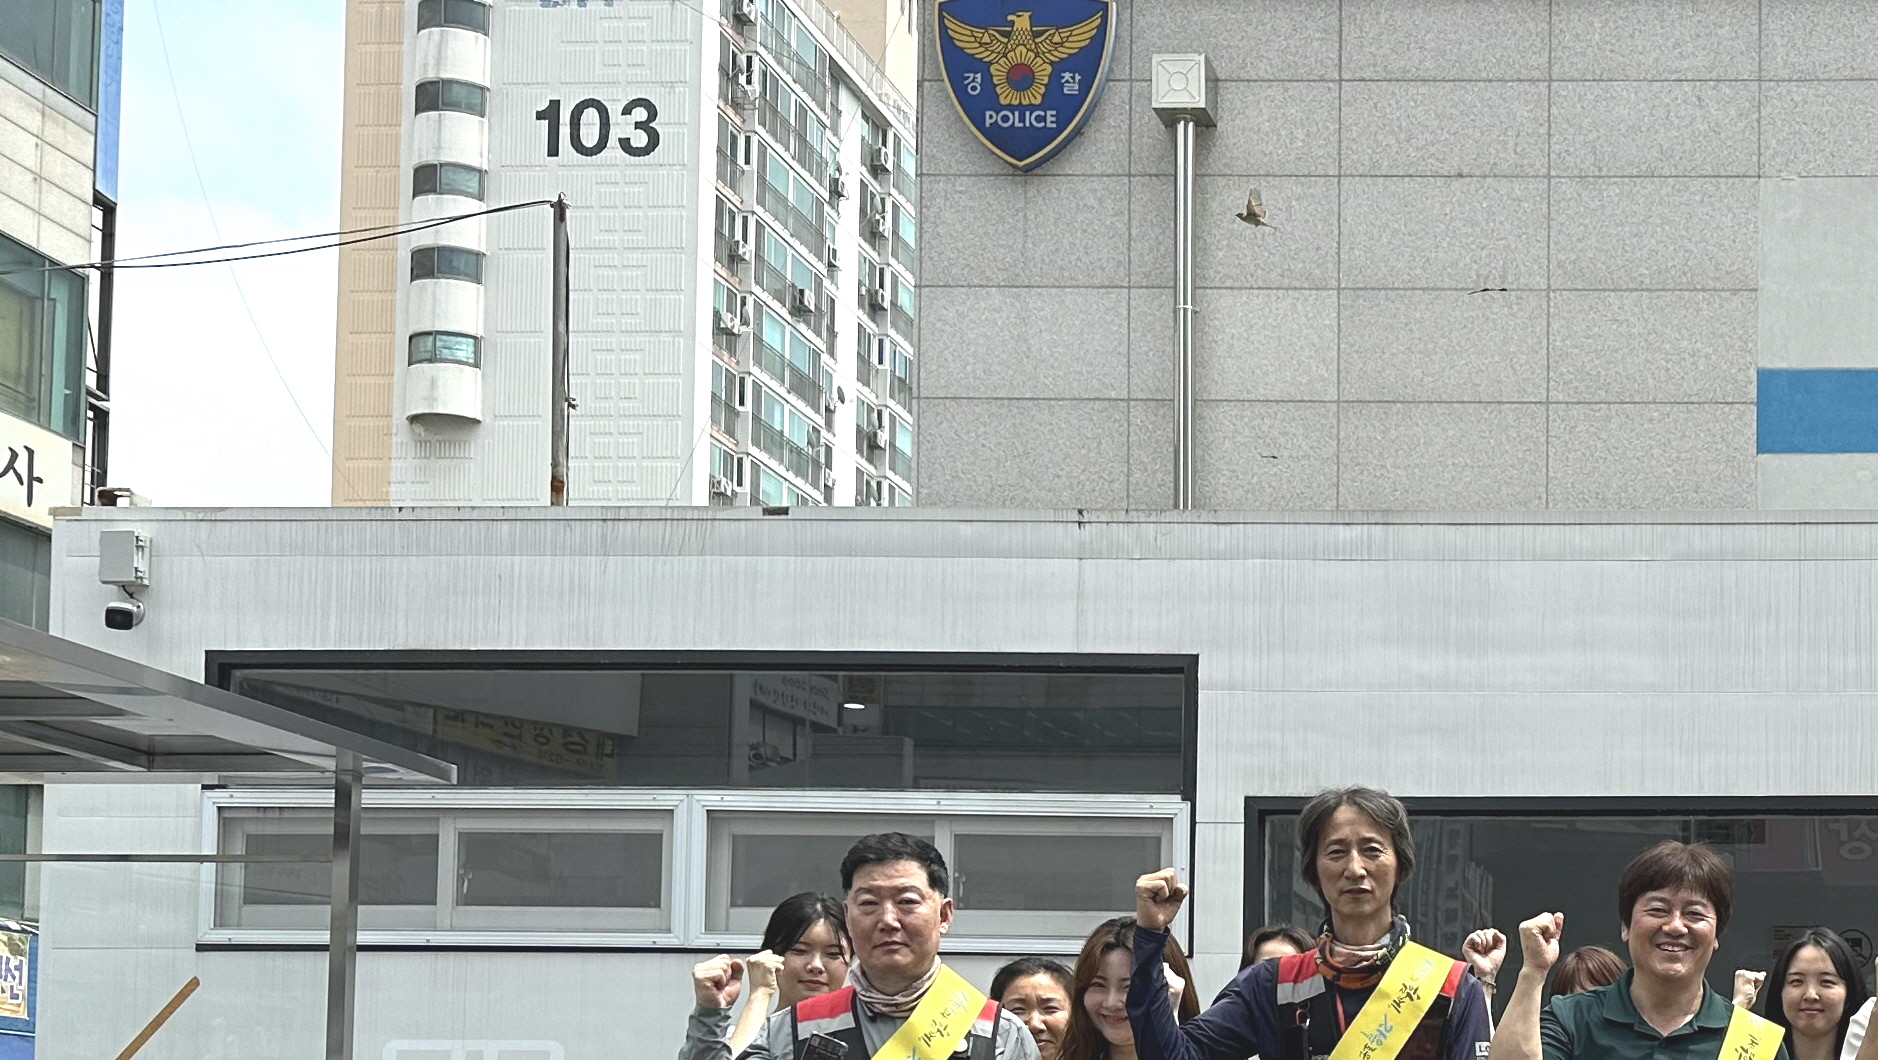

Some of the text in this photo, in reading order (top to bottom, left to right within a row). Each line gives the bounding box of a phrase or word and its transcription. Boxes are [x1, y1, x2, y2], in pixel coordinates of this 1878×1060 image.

[963, 71, 1082, 96] 경 찰
[535, 97, 660, 158] 103
[985, 110, 1057, 128] POLICE
